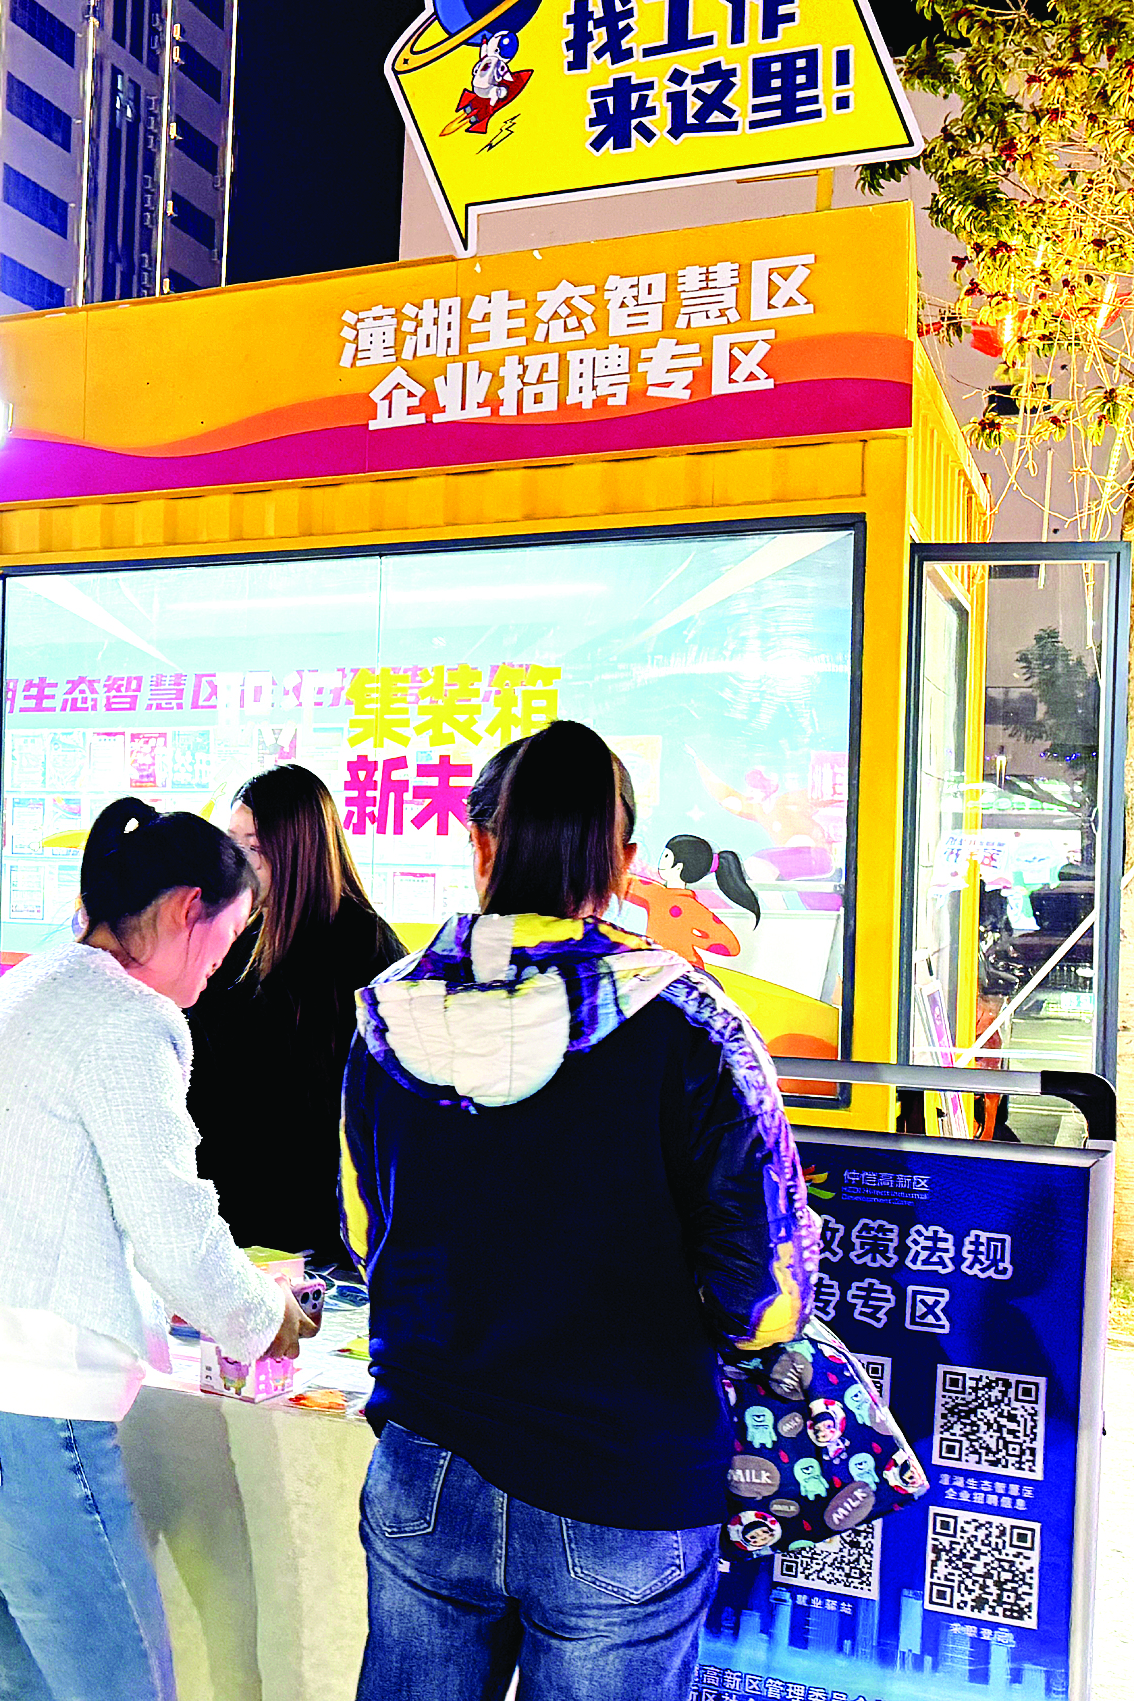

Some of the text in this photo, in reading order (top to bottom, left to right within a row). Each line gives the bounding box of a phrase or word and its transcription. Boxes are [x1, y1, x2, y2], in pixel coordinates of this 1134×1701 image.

[562, 0, 798, 73] 找工作
[586, 48, 853, 153] 来这里!
[338, 253, 817, 369] 潼湖生态智慧区
[367, 330, 777, 431] 企业招聘专区
[831, 1488, 868, 1526] MILK
[694, 1664, 864, 1701] 高新区管理委
